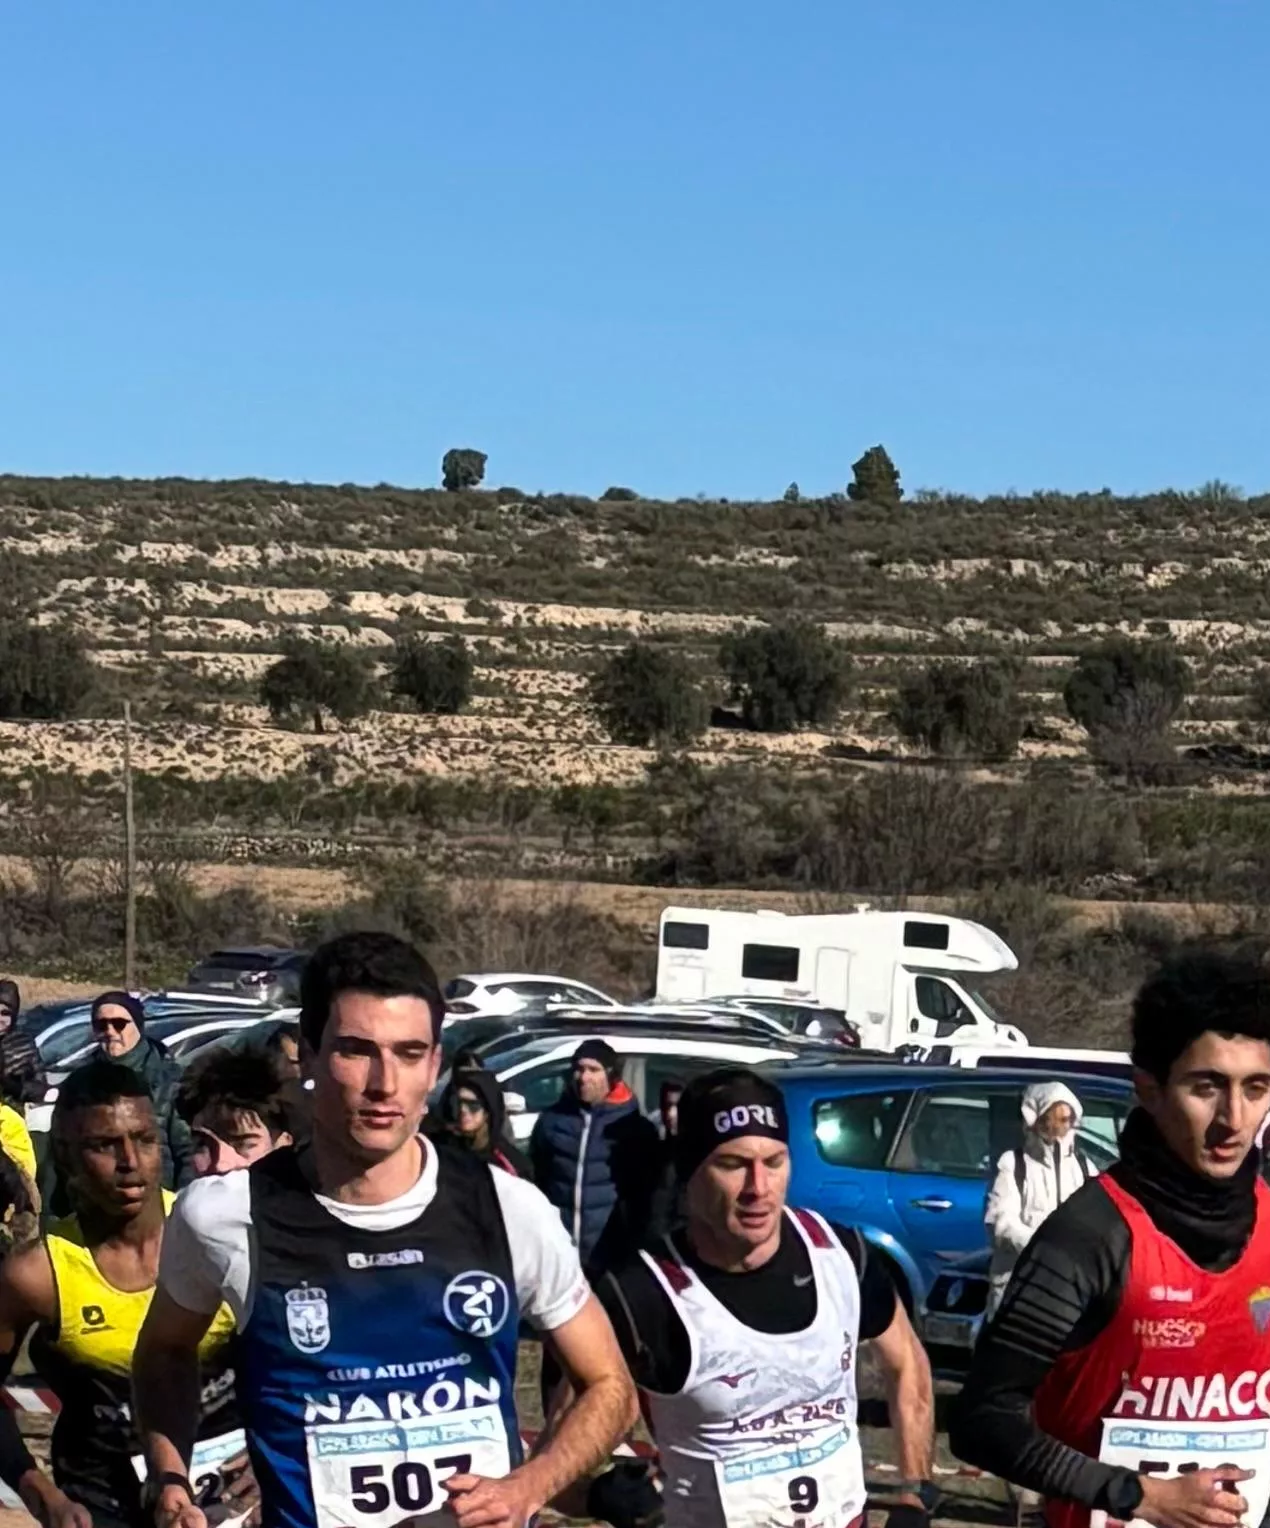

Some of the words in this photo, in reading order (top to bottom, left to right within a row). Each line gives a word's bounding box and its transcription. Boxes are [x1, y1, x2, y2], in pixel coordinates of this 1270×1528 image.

[327, 1367, 371, 1381] CLUB
[350, 1453, 472, 1514] 507
[788, 1475, 819, 1514] 9
